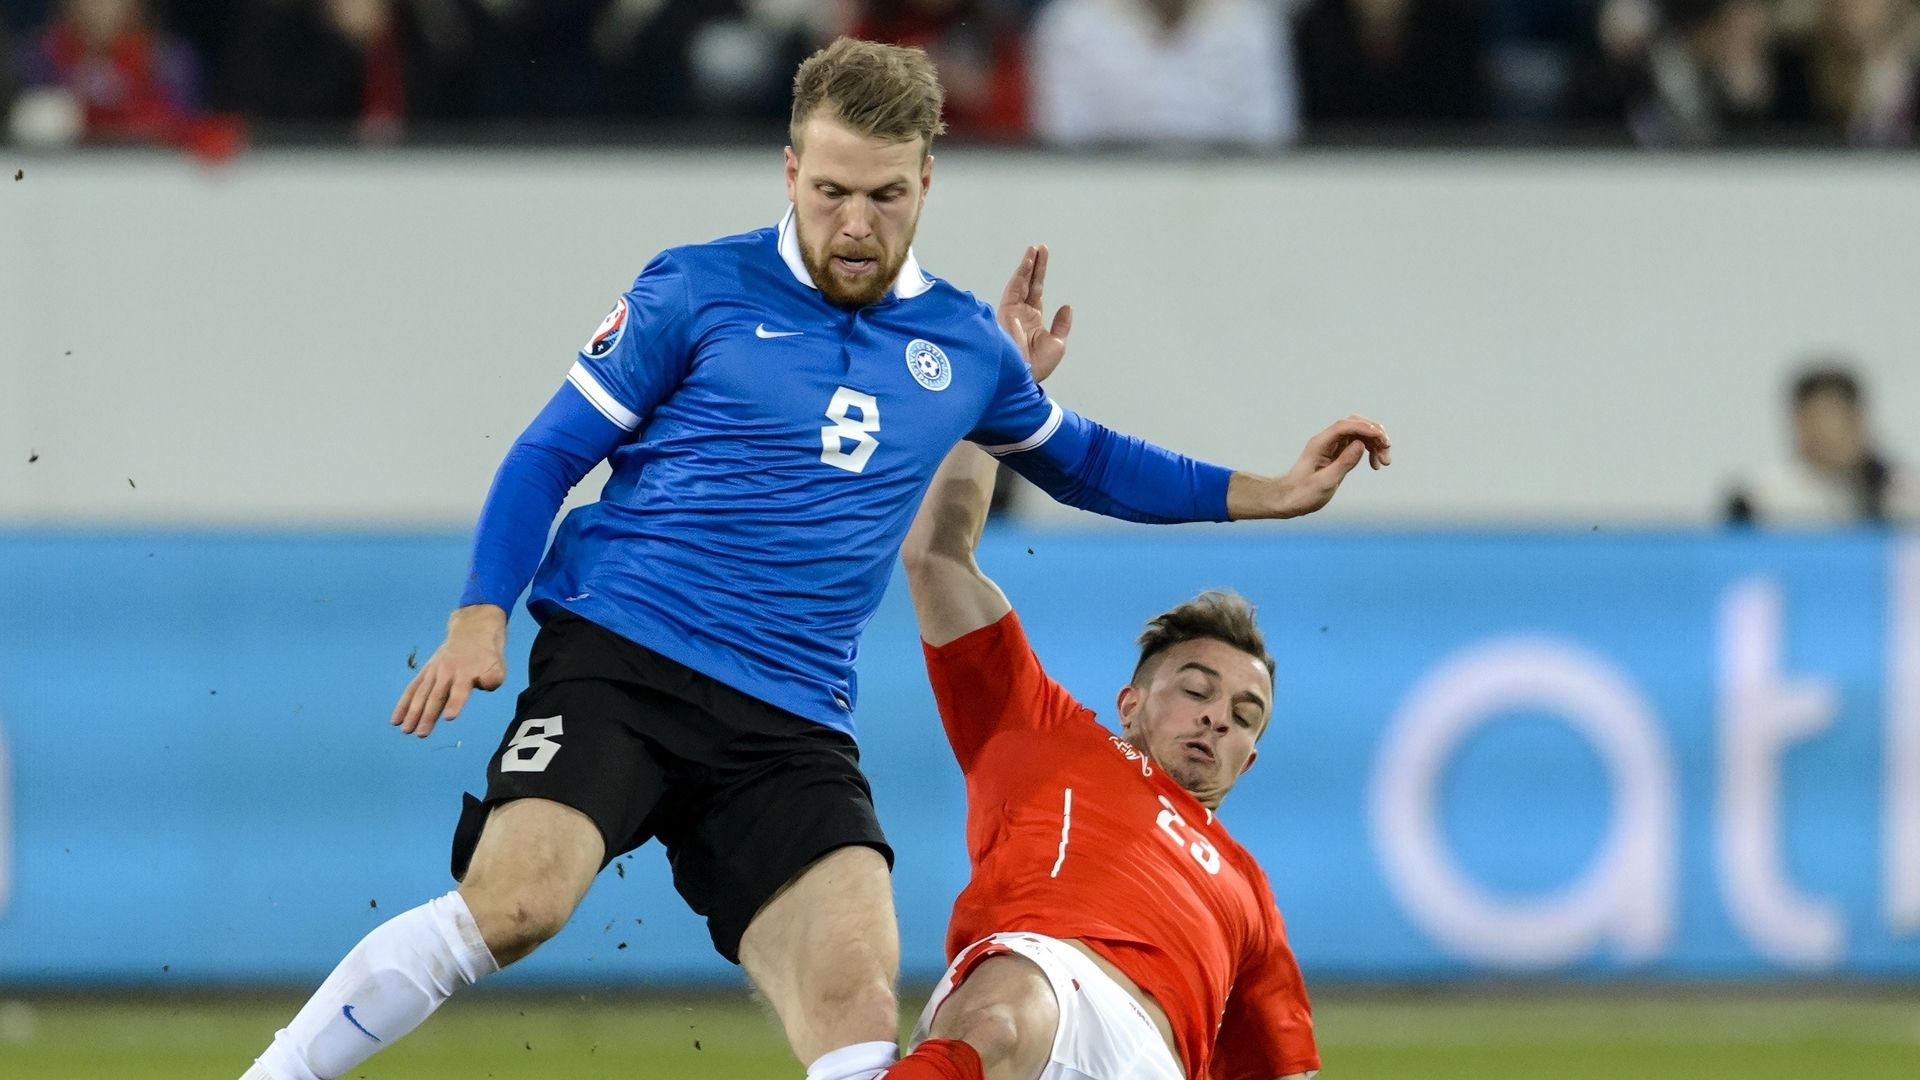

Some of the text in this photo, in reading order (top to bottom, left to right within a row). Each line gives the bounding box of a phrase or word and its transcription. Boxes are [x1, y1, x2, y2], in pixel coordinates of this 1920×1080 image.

[820, 386, 880, 473] 8
[501, 715, 563, 772] 8
[1156, 795, 1220, 875] 23
